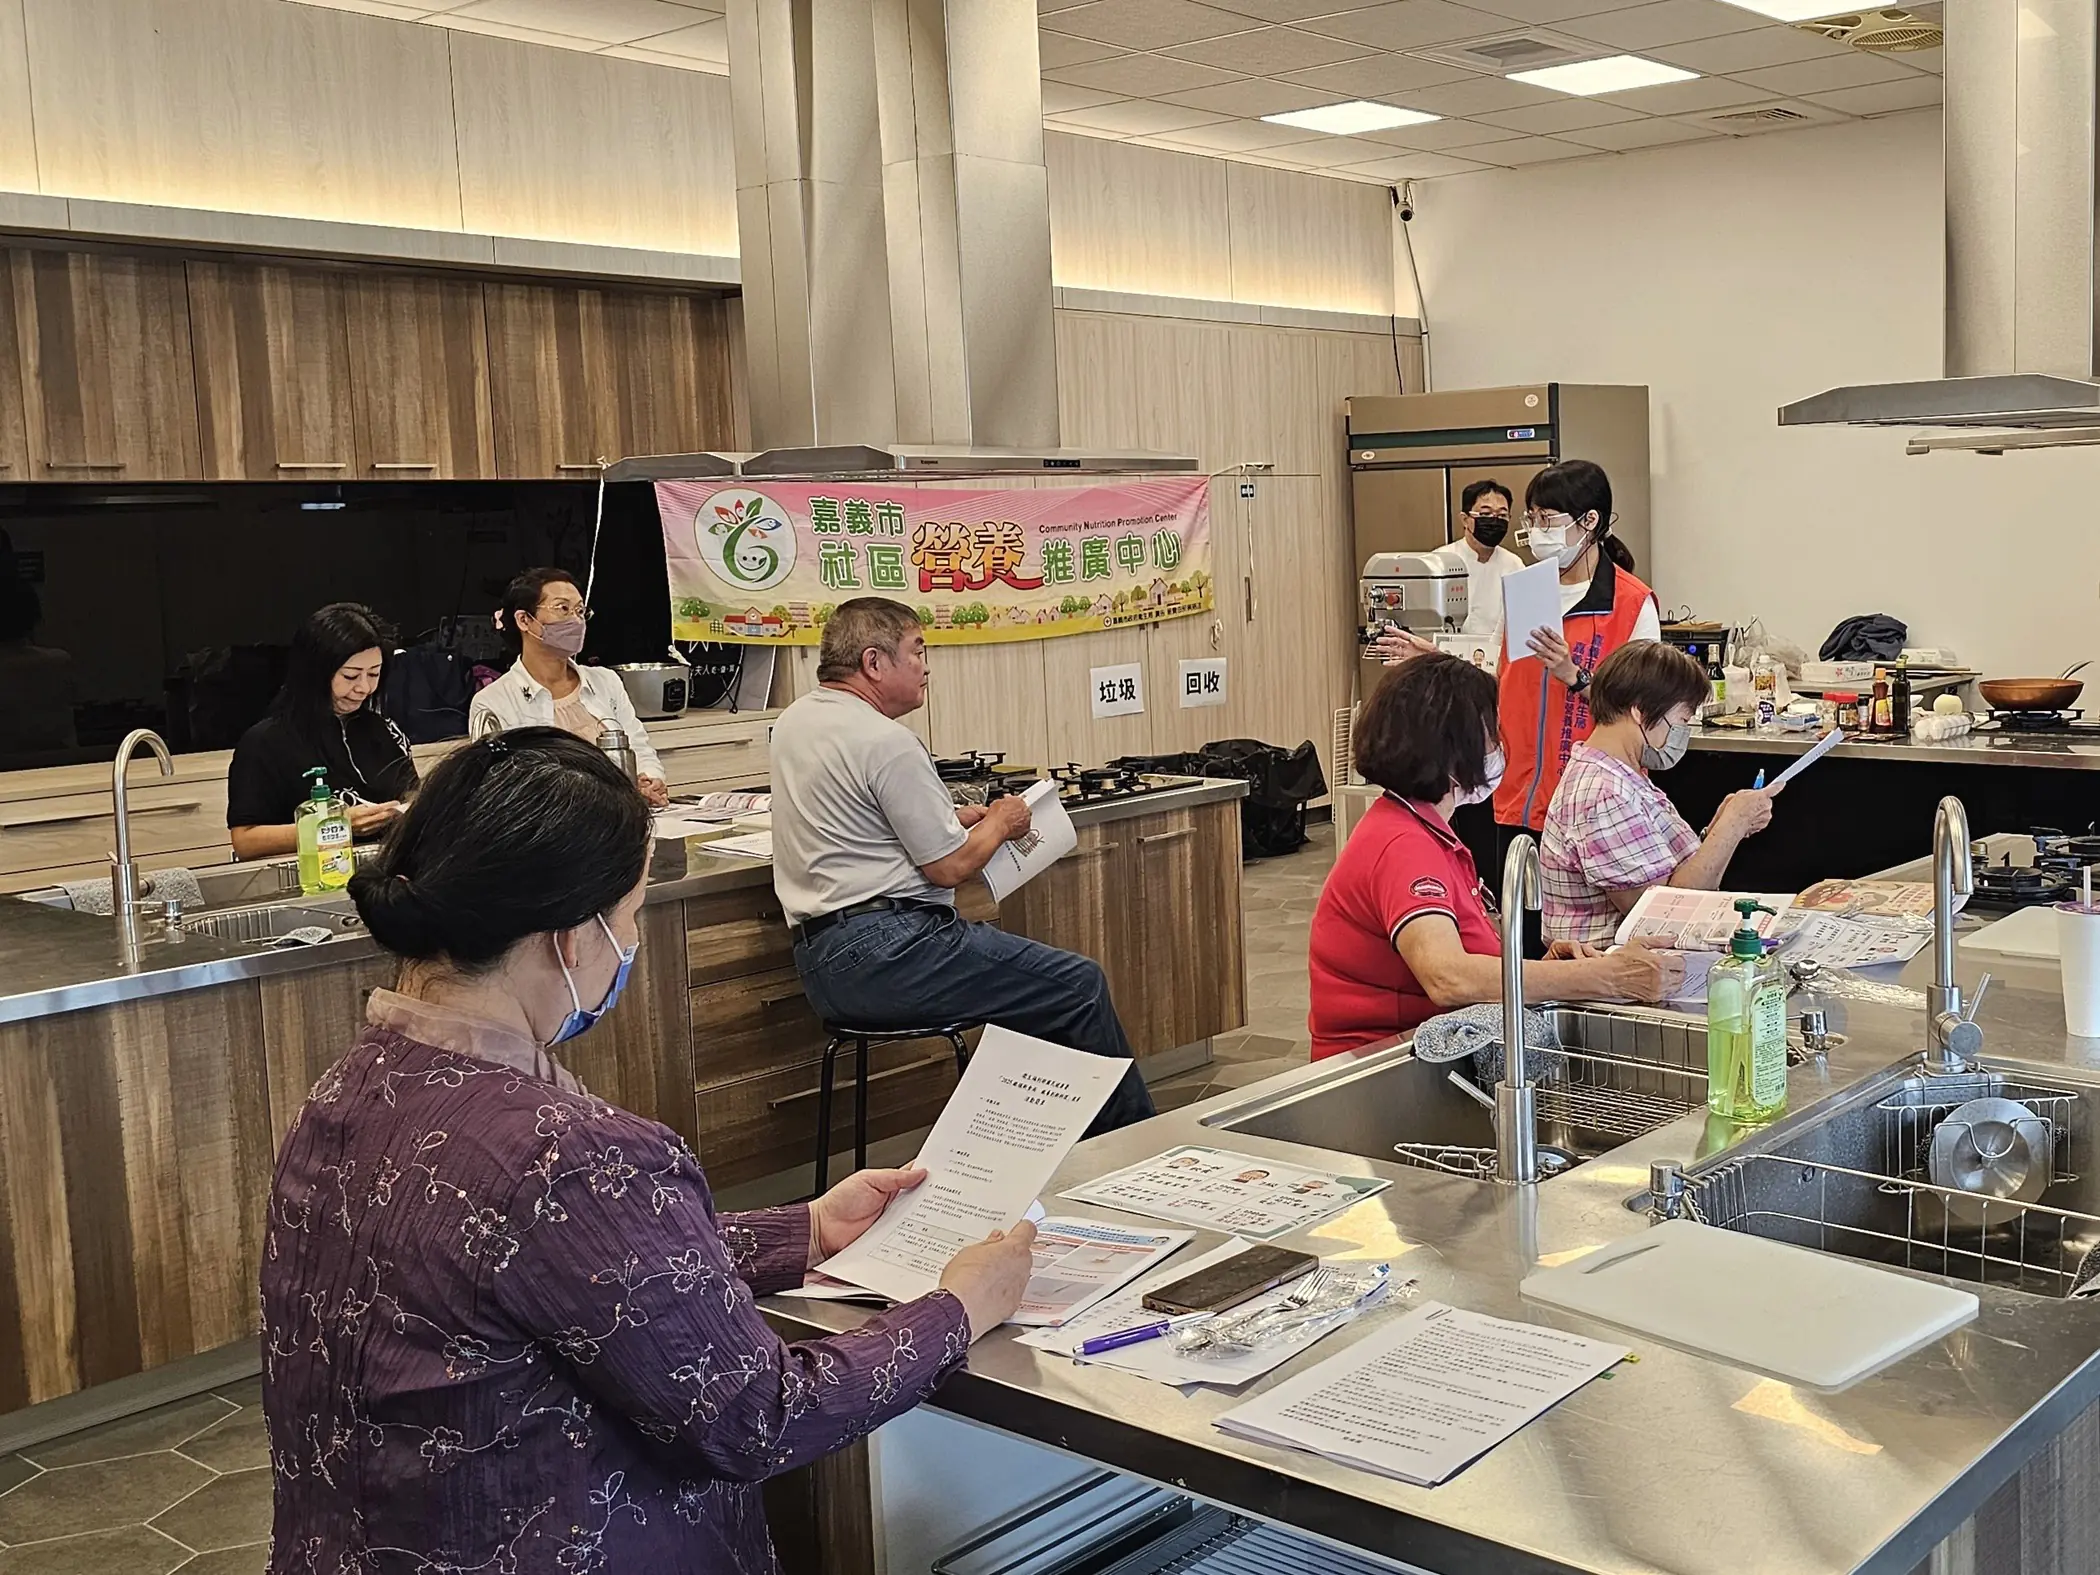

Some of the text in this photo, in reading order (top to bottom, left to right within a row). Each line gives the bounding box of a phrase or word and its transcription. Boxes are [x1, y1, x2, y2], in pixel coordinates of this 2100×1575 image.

[809, 496, 905, 537] 嘉義市
[1039, 513, 1178, 534] Community Nutrition Promotion Center
[1099, 677, 1137, 704] 垃圾
[1186, 670, 1221, 696] 回收
